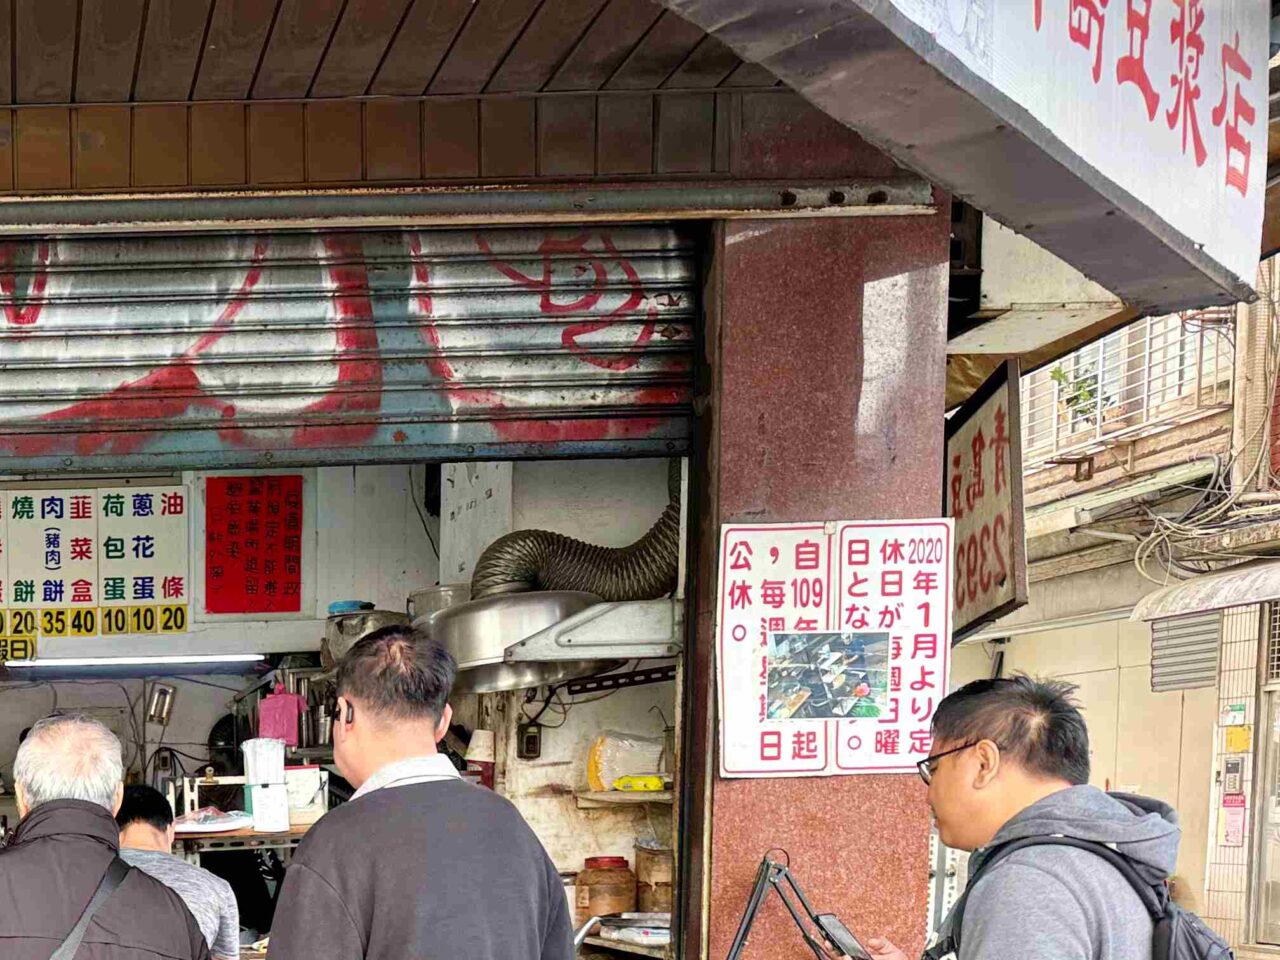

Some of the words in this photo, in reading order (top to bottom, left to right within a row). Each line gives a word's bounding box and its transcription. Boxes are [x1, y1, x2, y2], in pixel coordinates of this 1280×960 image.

[70, 496, 93, 602] 韭菜盒
[103, 494, 125, 600] 荷包蛋
[13, 611, 34, 634] 20
[43, 610, 65, 634] 35
[72, 610, 94, 633] 40
[104, 609, 125, 632] 10
[132, 608, 154, 631] 10
[162, 607, 184, 630] 20
